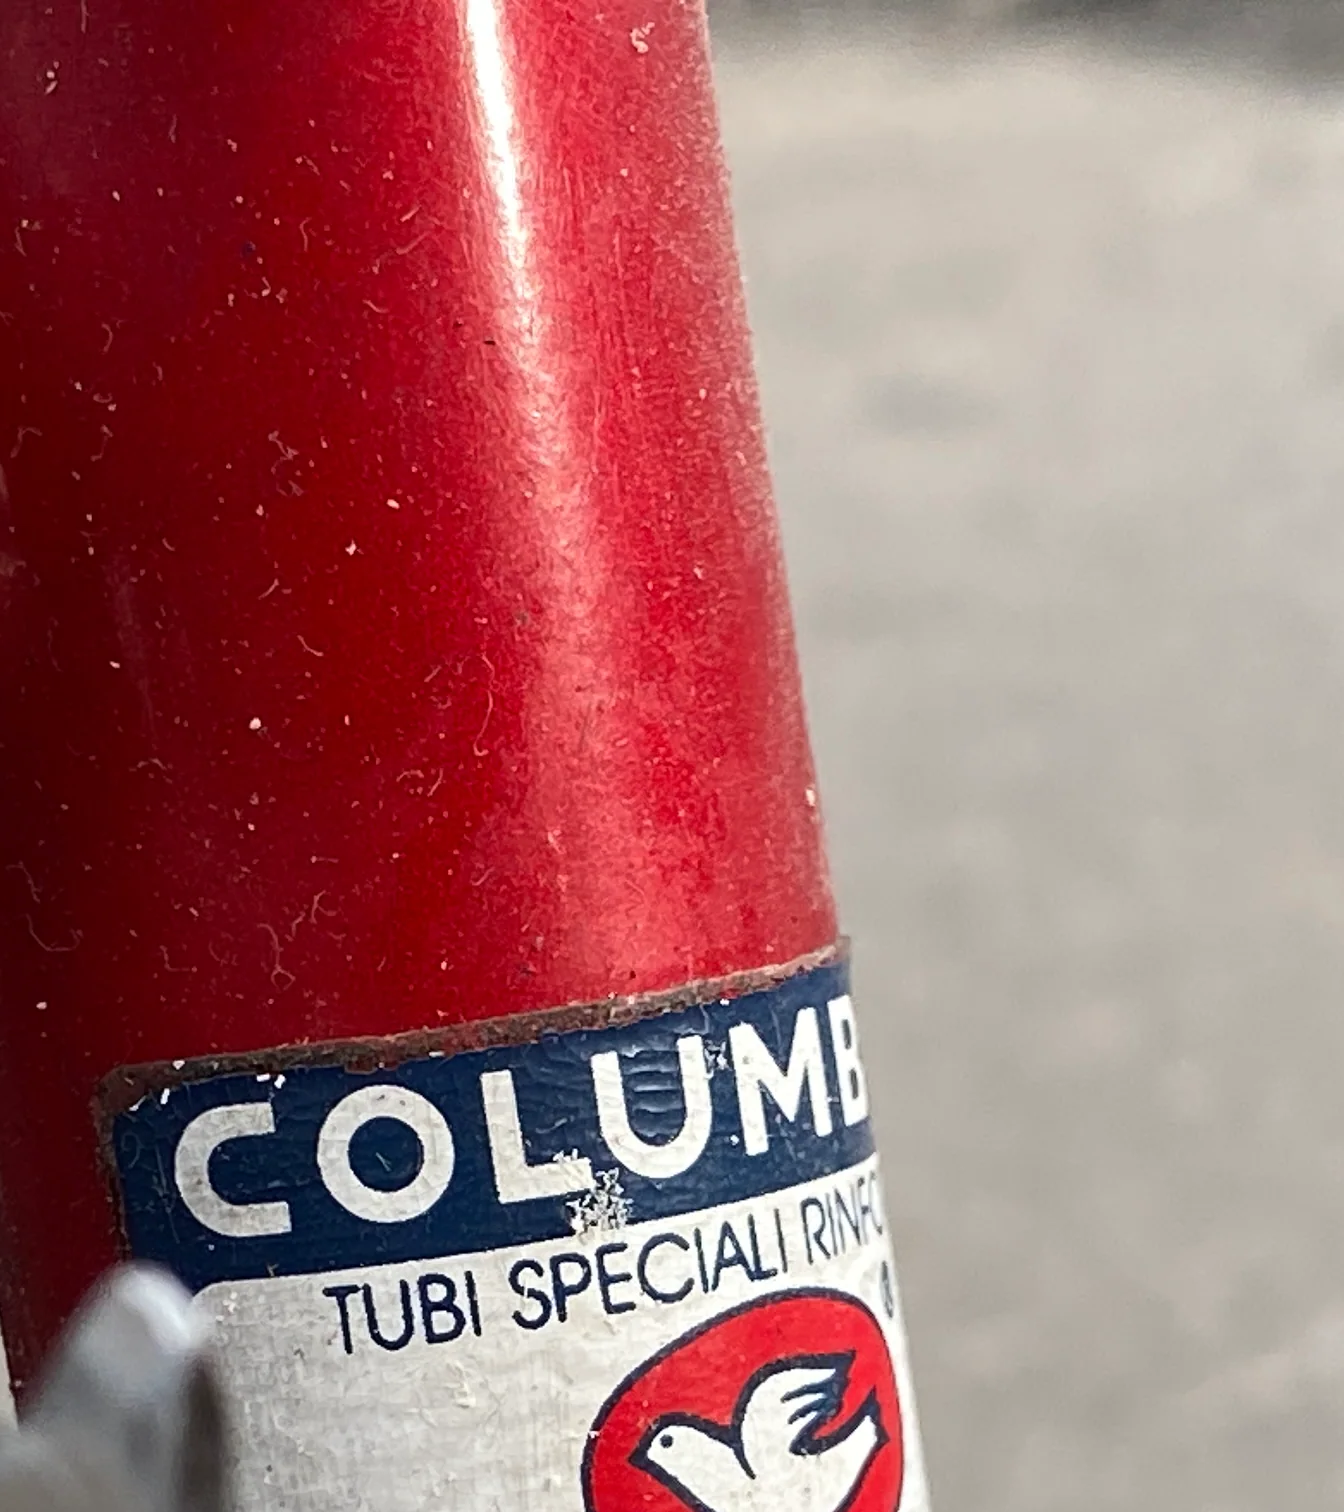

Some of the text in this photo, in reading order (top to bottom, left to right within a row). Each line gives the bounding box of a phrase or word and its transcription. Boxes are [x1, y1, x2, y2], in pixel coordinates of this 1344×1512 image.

[172, 994, 870, 1239] COLUMB
[322, 1270, 483, 1355] TUBI
[508, 1207, 789, 1331] SPECIALI
